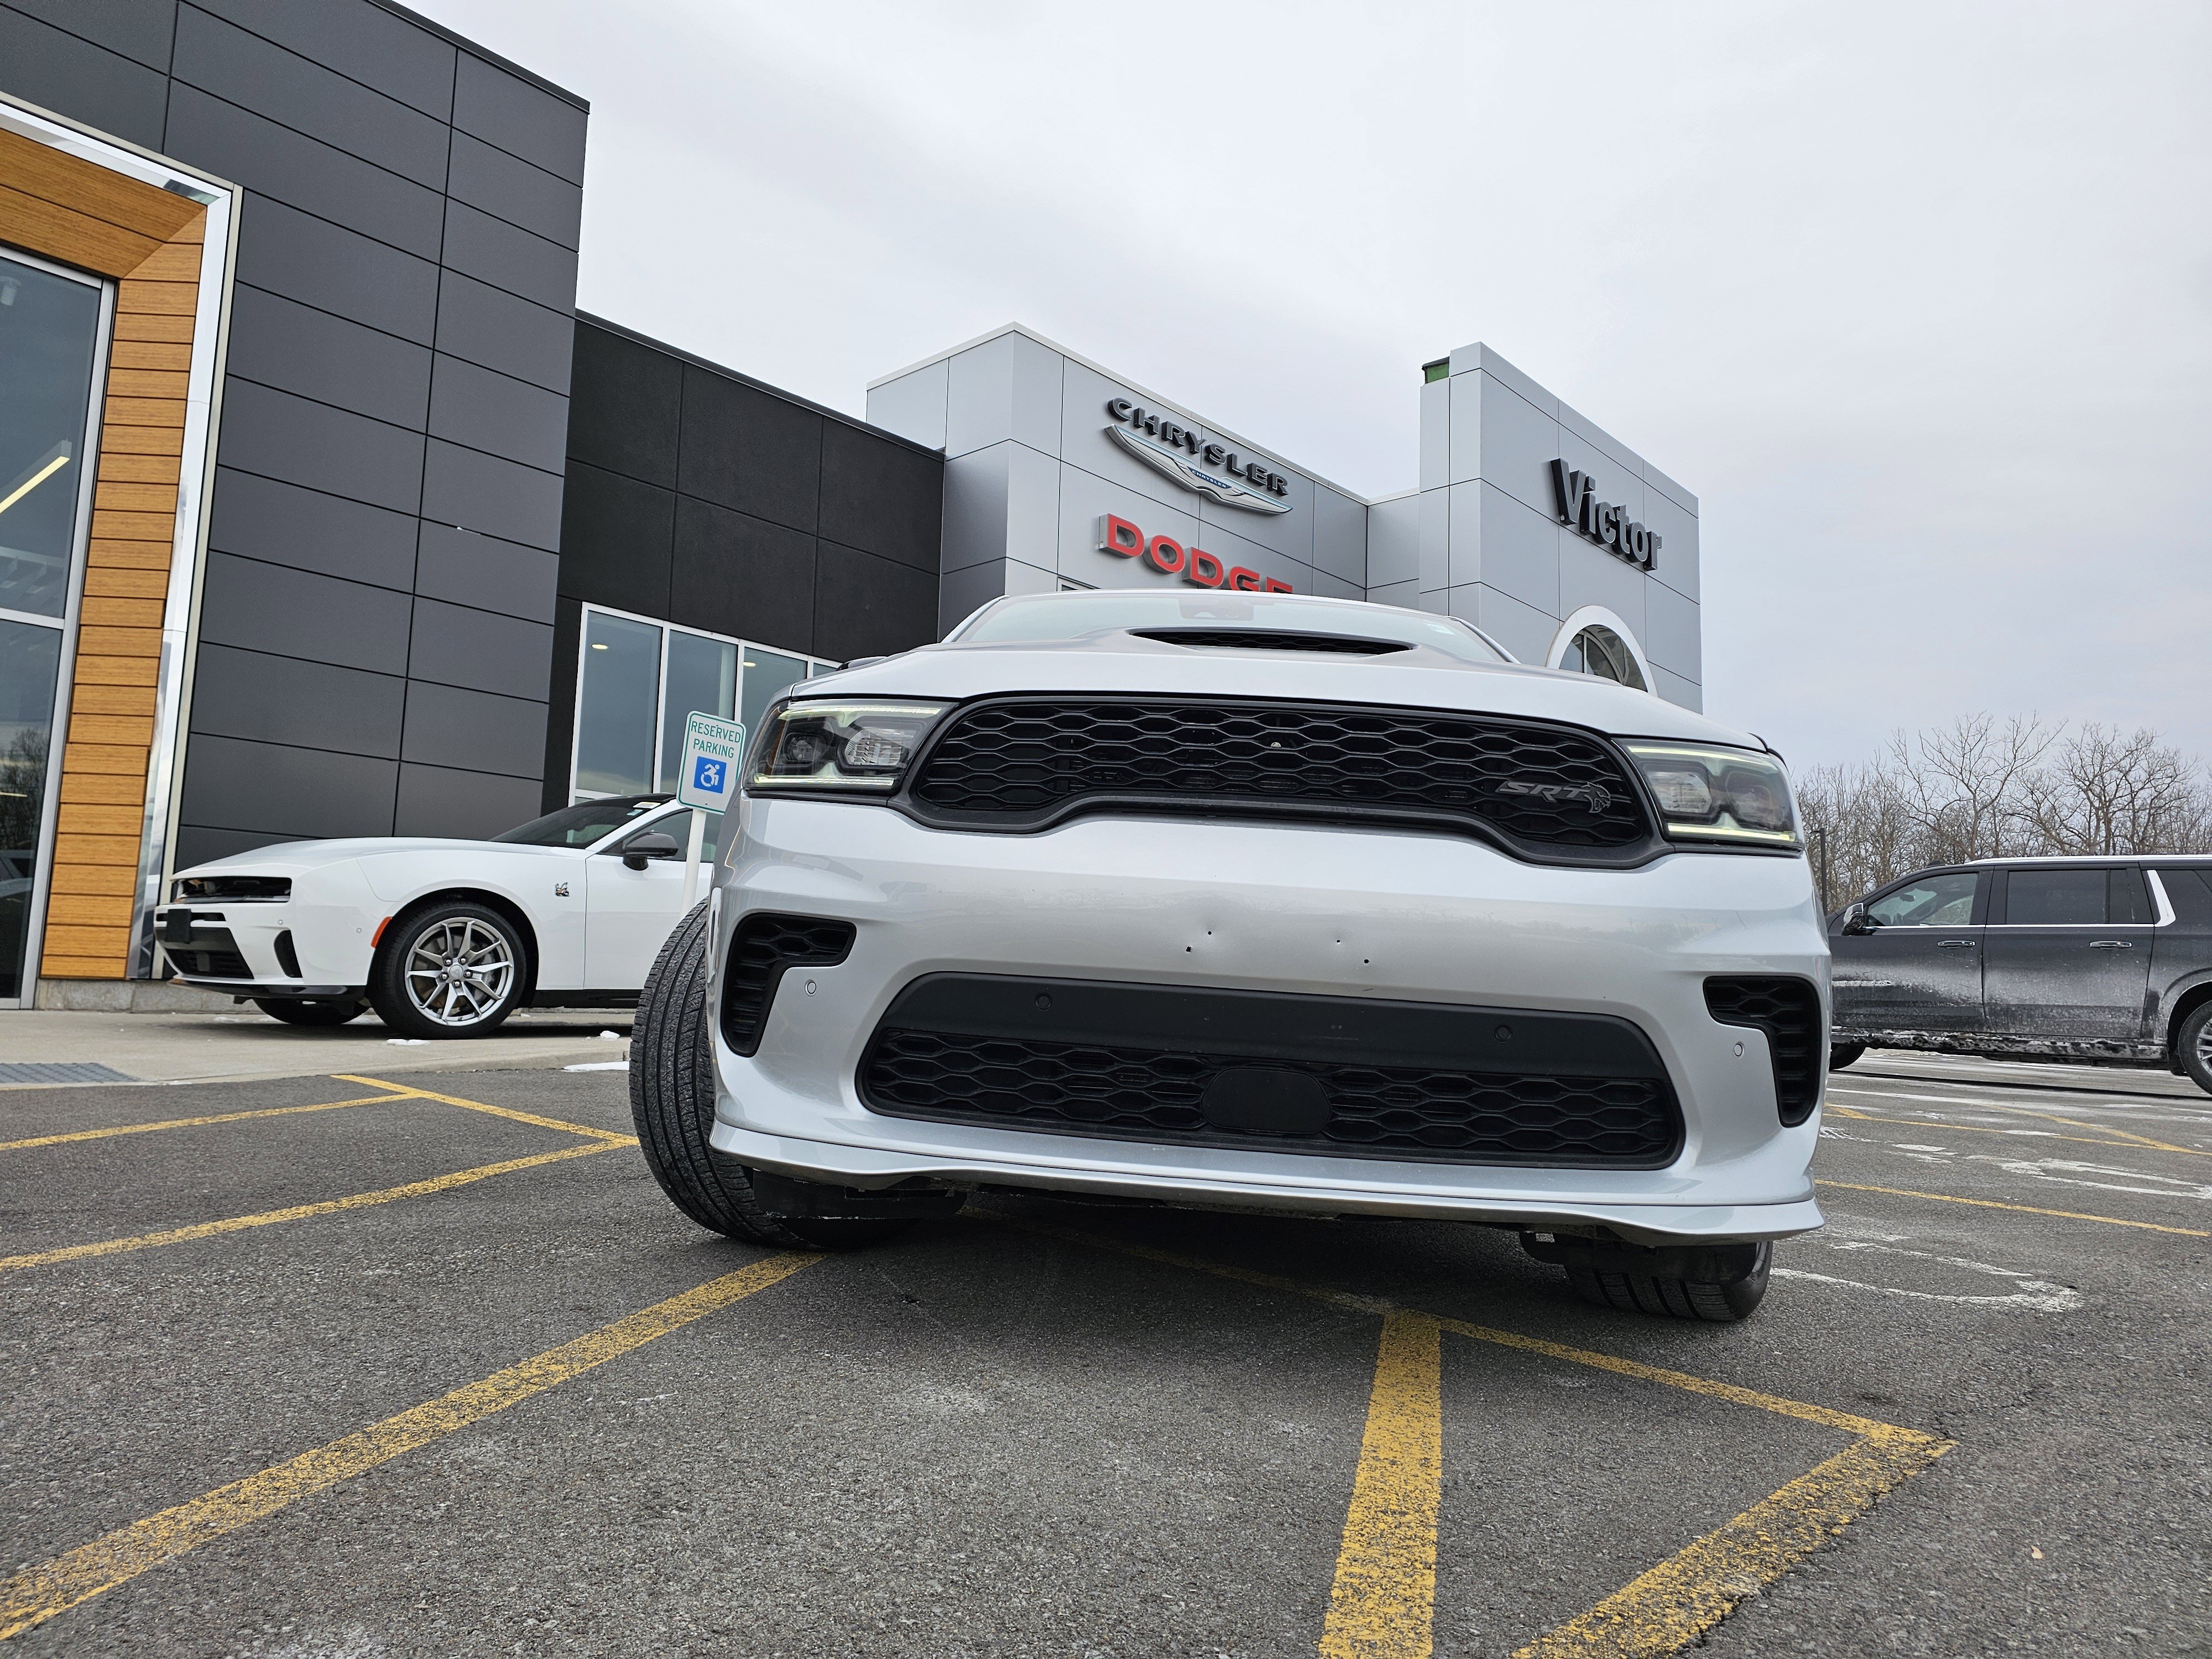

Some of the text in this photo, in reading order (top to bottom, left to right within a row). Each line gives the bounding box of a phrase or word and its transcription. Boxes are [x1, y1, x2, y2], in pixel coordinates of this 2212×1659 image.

[1107, 397, 1288, 495] CHRYSLER
[1192, 470, 1227, 488] CHRYSLER
[1550, 458, 1662, 571] Victor
[691, 721, 740, 743] RESERVED
[693, 738, 734, 758] PARKING
[1499, 781, 1590, 801] SRT
